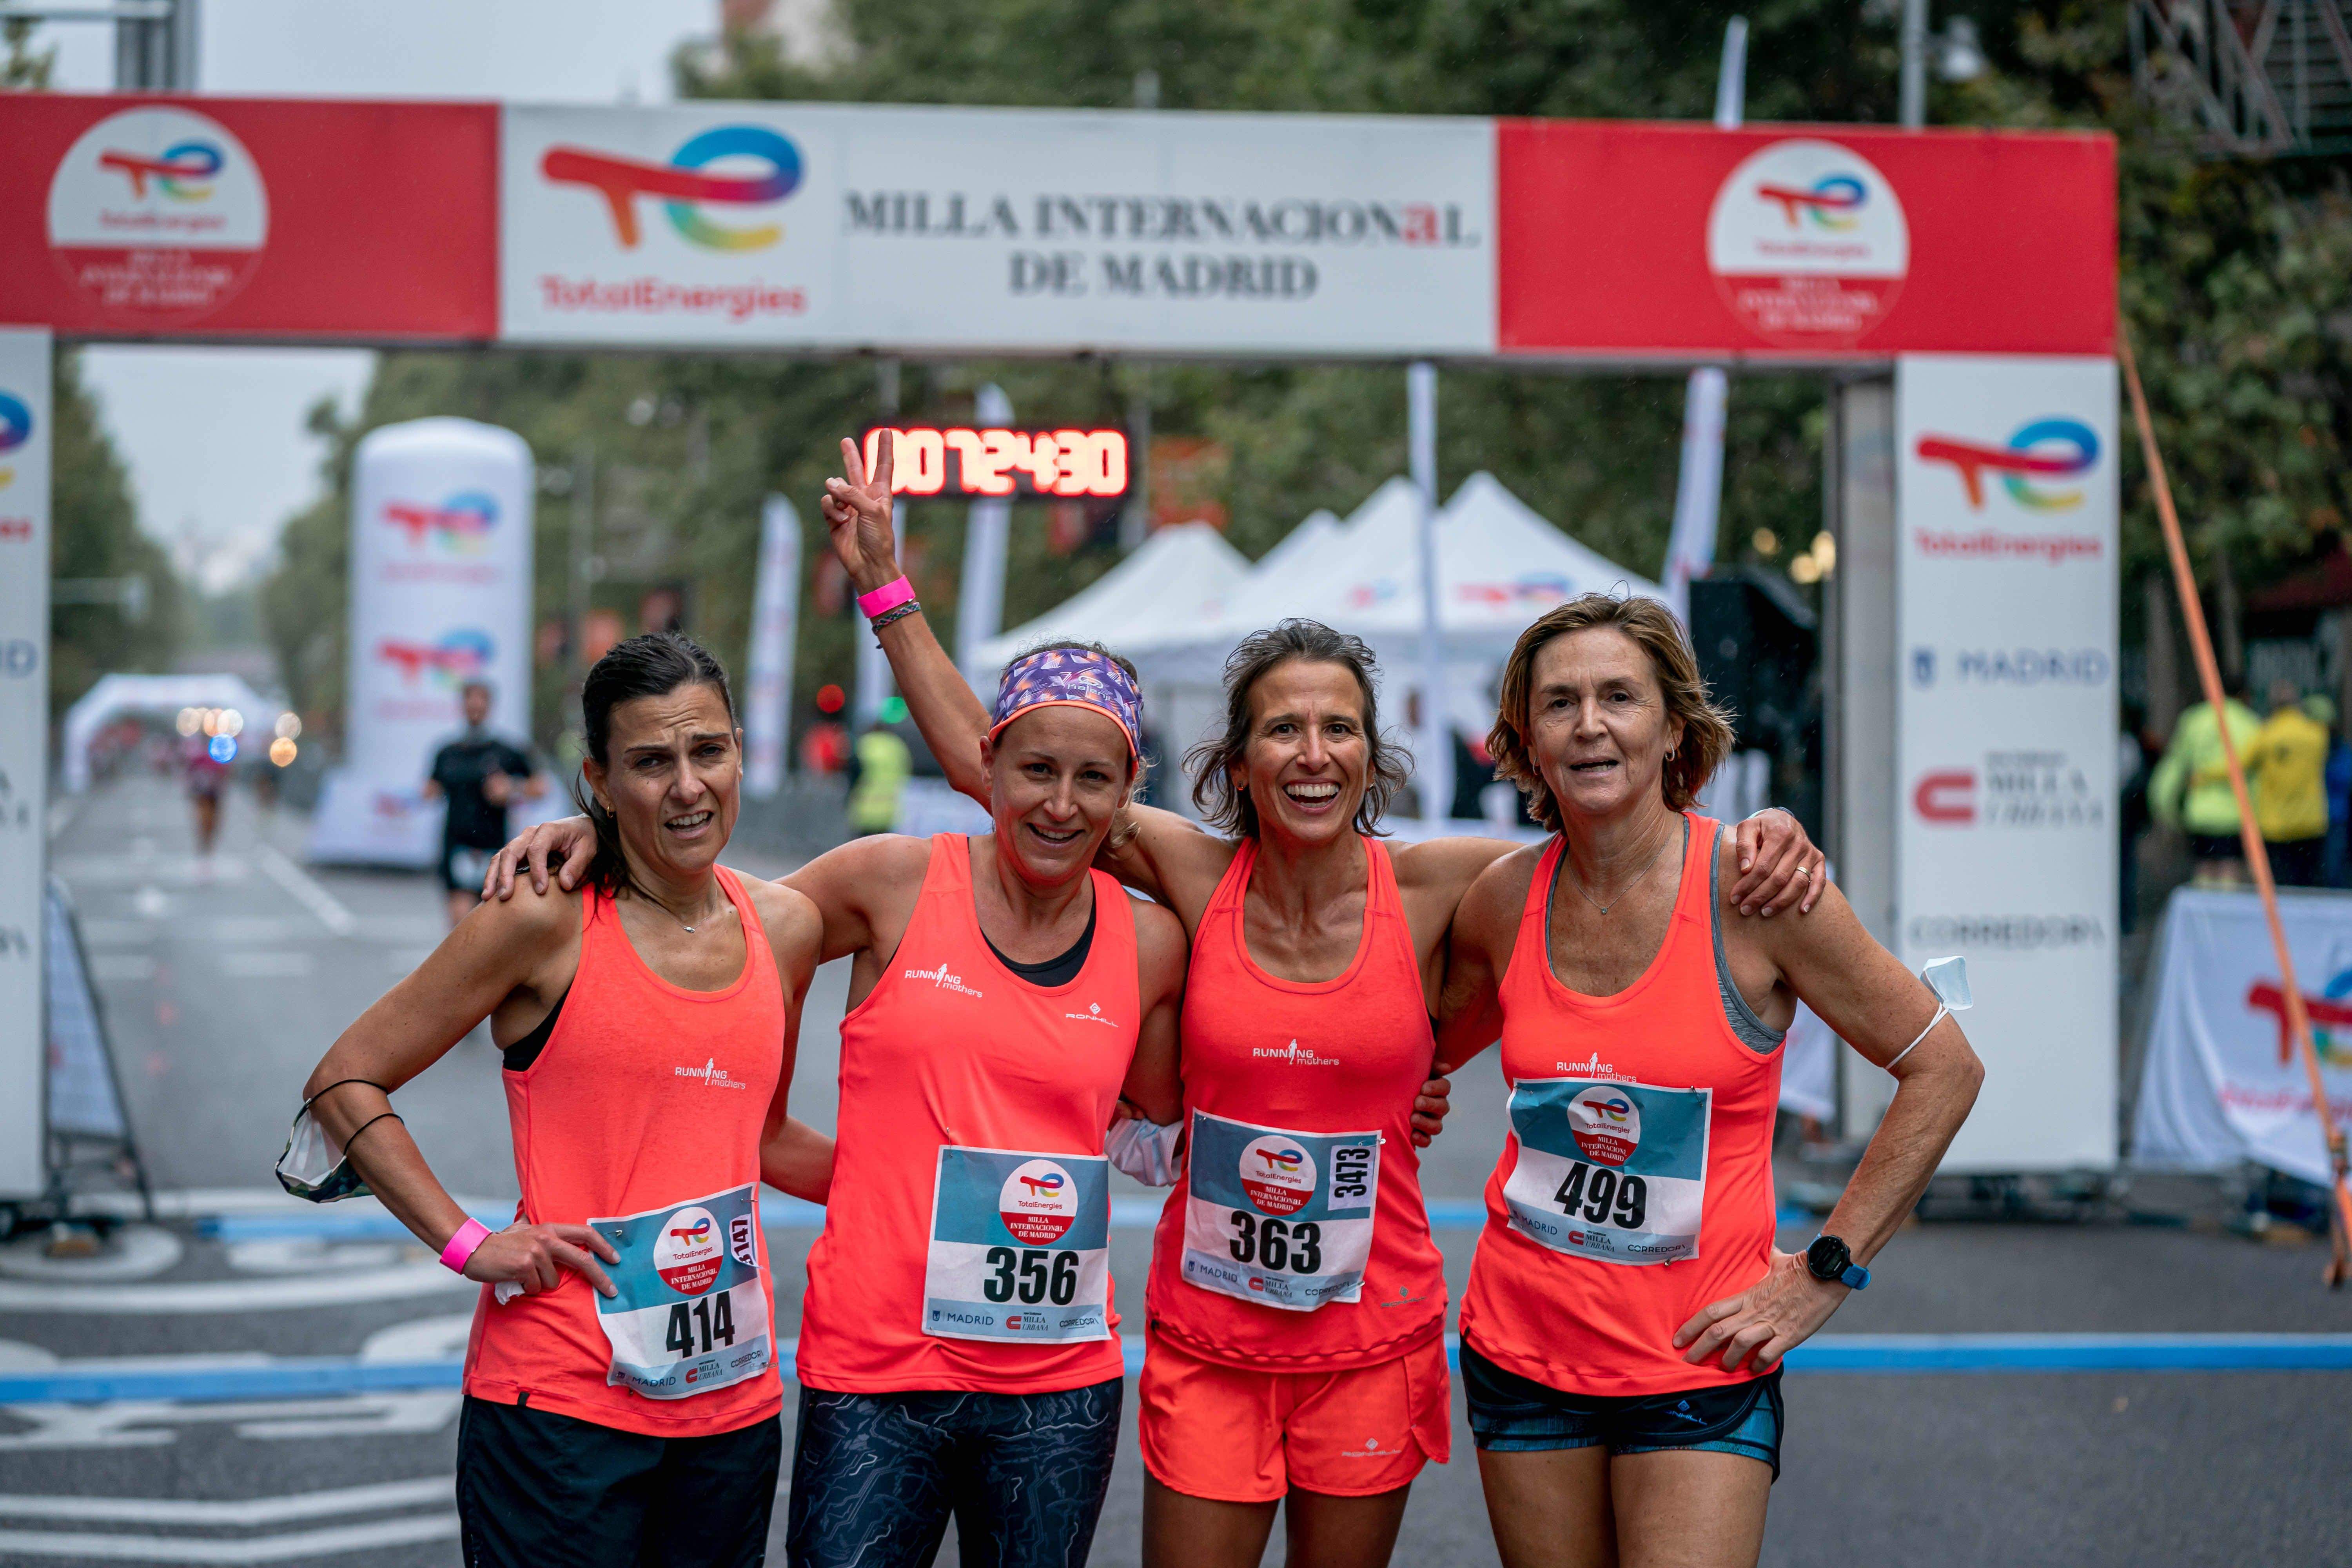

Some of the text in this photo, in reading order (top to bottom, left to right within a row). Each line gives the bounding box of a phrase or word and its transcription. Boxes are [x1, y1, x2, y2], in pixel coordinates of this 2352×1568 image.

[845, 190, 1019, 240] MILLA
[1008, 250, 1320, 300] DE MADRID
[541, 275, 808, 322] TotalEnergies
[1914, 527, 2103, 564] TotalEnergies
[1959, 649, 2109, 687] MADRID
[943, 982, 983, 998] mothers
[1065, 1013, 1119, 1027] RONHILL
[1297, 1057, 1339, 1065] mothers
[1597, 1072, 1637, 1083] mothers
[711, 1079, 746, 1089] mothers
[1585, 1122, 1630, 1134] TotalEnergies
[1598, 1136, 1618, 1145] MILLA
[1601, 1151, 1624, 1161] MADRID
[1256, 1170, 1301, 1183] TotalEnergies
[1334, 1149, 1370, 1198] 3473
[1266, 1186, 1287, 1196] MILLA
[1553, 1161, 1647, 1229] 499
[1018, 1200, 1062, 1210] TotalEnergies
[1267, 1201, 1294, 1211] MADRID
[1522, 1216, 1557, 1235] MADRID
[1230, 1210, 1321, 1274] 363
[1586, 1234, 1611, 1245] MILLA
[1586, 1241, 1614, 1252] URBANA
[673, 1246, 713, 1260] TotalEnergies
[688, 1264, 706, 1273] MILLA
[1201, 1265, 1237, 1282] MADRID
[984, 1247, 1079, 1305] 356
[691, 1277, 712, 1288] MADRID
[1265, 1280, 1289, 1290] MILLA
[666, 1290, 735, 1358] 414
[947, 1313, 994, 1325] MADRID
[699, 1362, 719, 1372] MILLA
[699, 1368, 722, 1380] URBANA
[632, 1377, 676, 1387] MADRID
